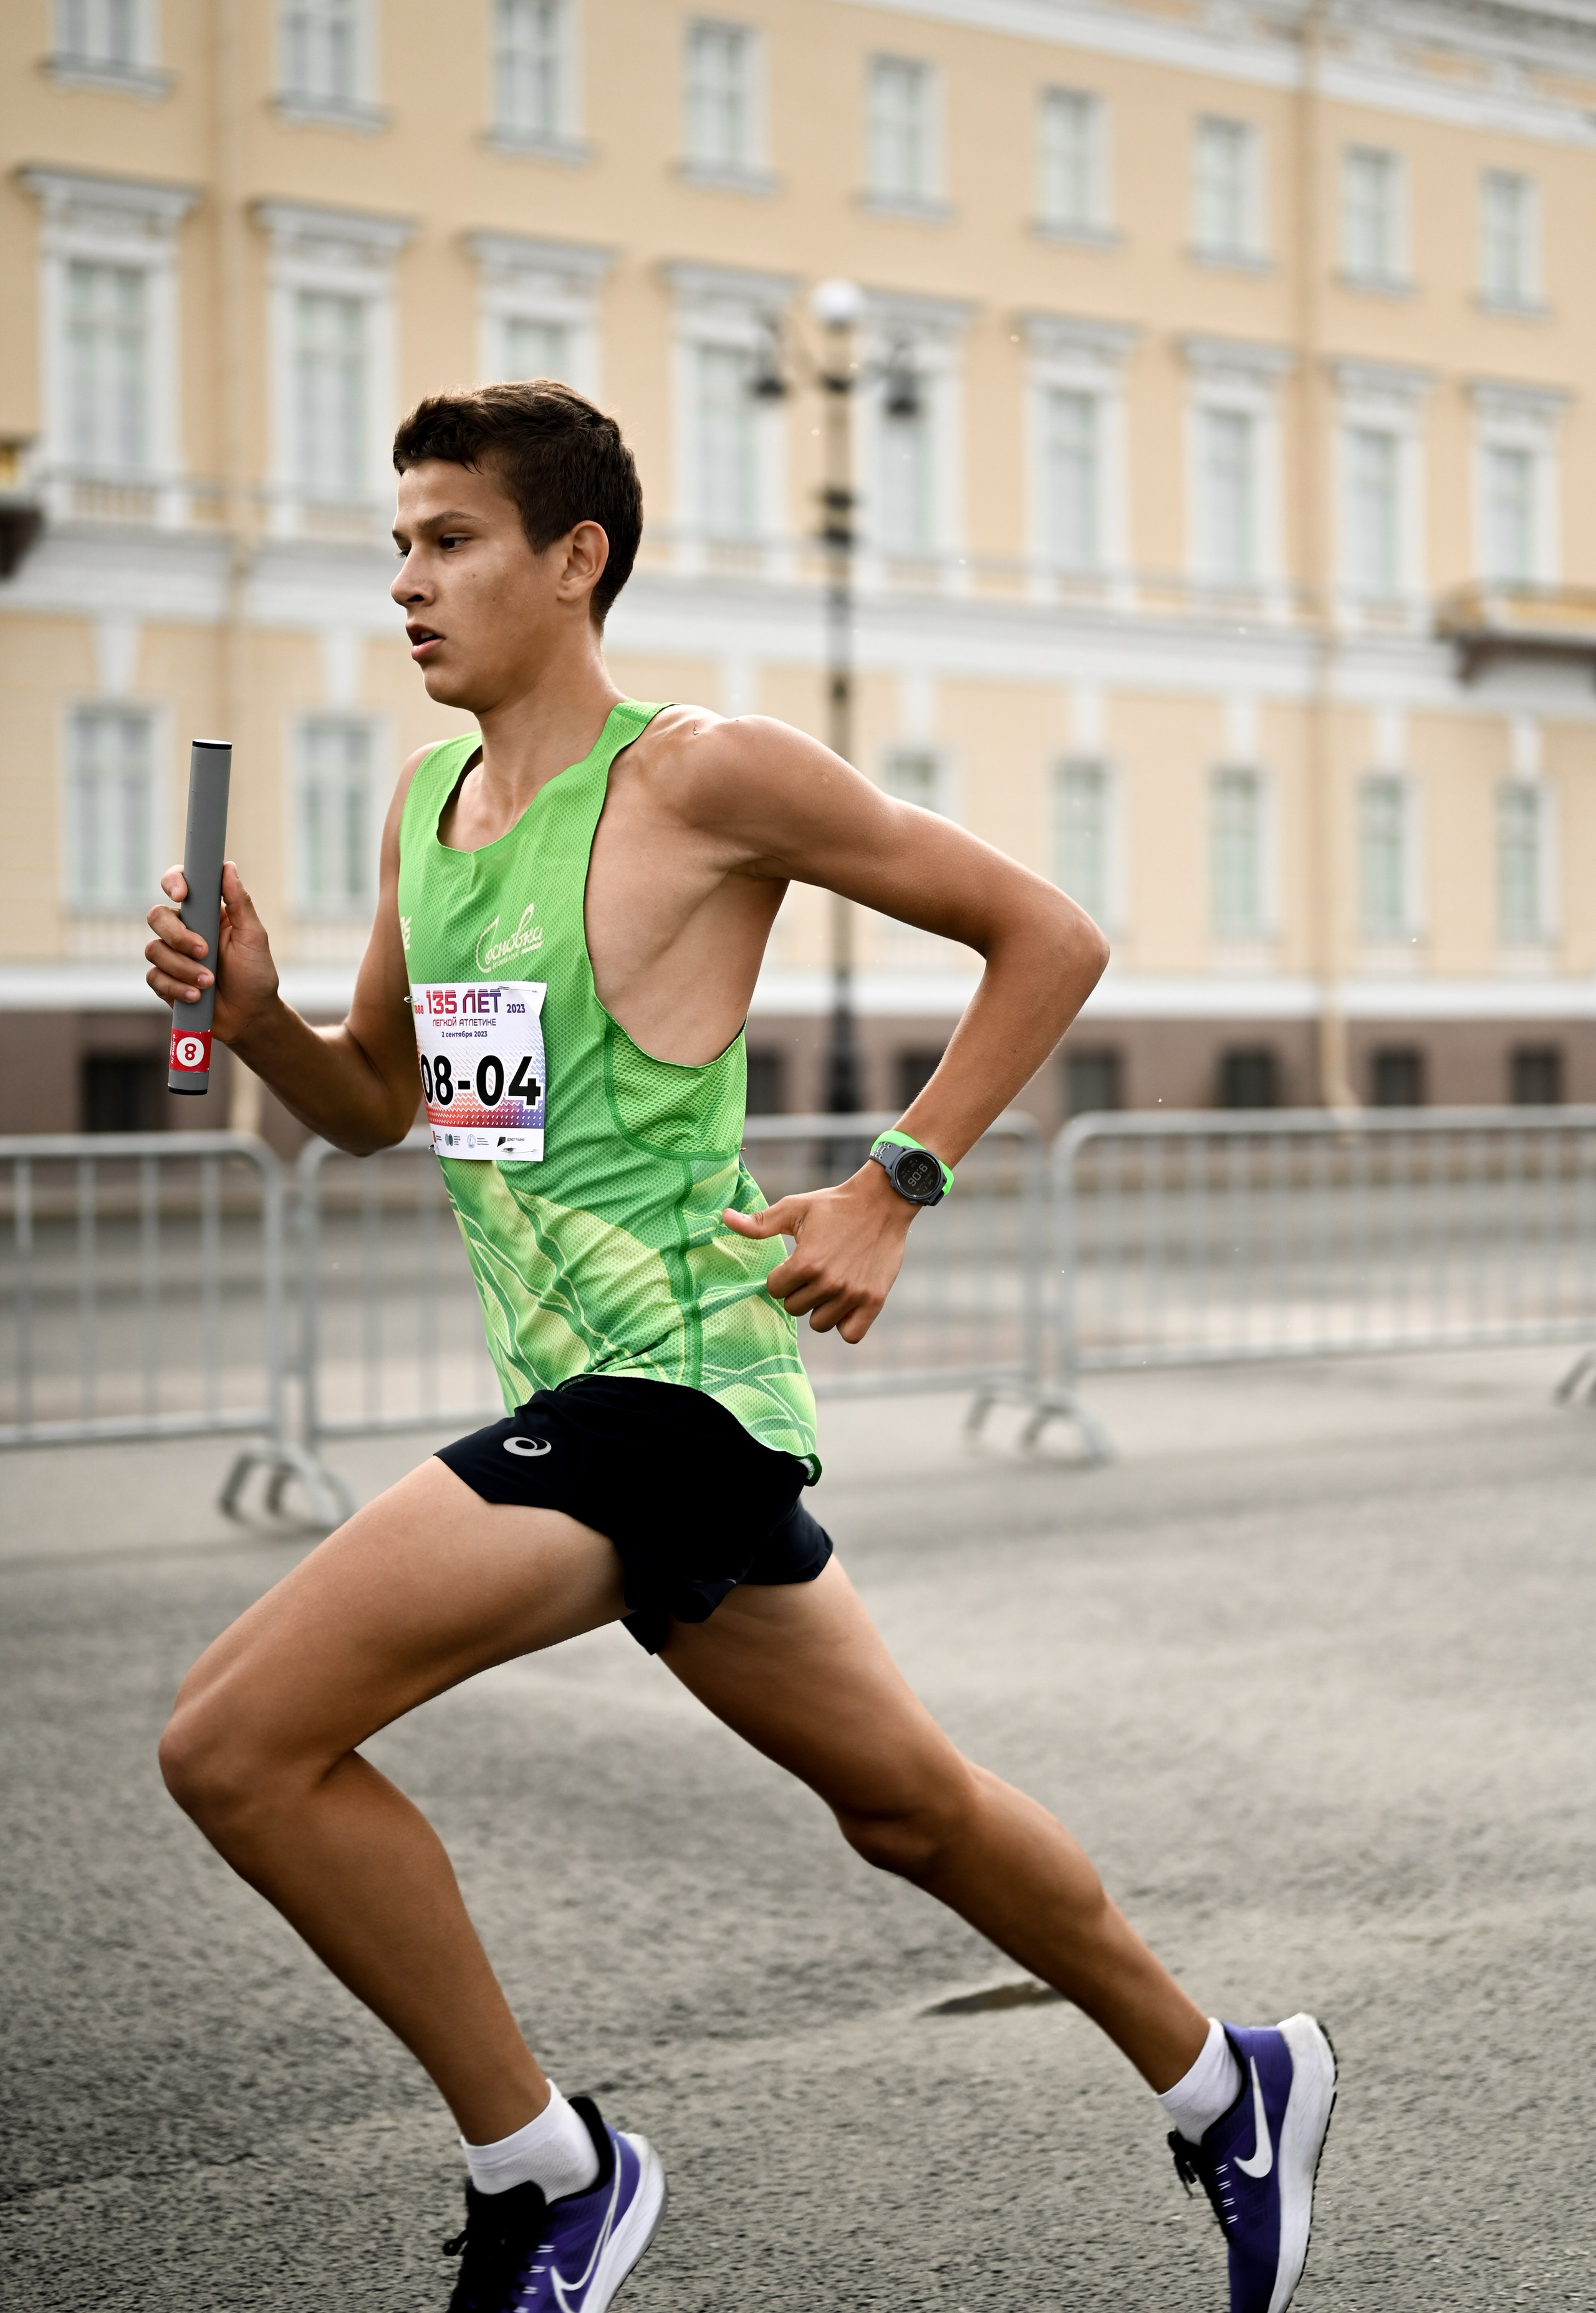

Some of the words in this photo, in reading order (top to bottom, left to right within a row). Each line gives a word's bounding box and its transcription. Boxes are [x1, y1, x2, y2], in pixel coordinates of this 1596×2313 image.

[426, 989, 457, 1014] 135
[463, 989, 501, 1014] ЛЕТ
[506, 1004, 526, 1014] 2023
[433, 1016, 457, 1027] ЛЕГКОЙ
[459, 1018, 496, 1026] АТЛЕТИКЕ
[185, 1043, 196, 1060] 8
[420, 1054, 541, 1106] 08-04
